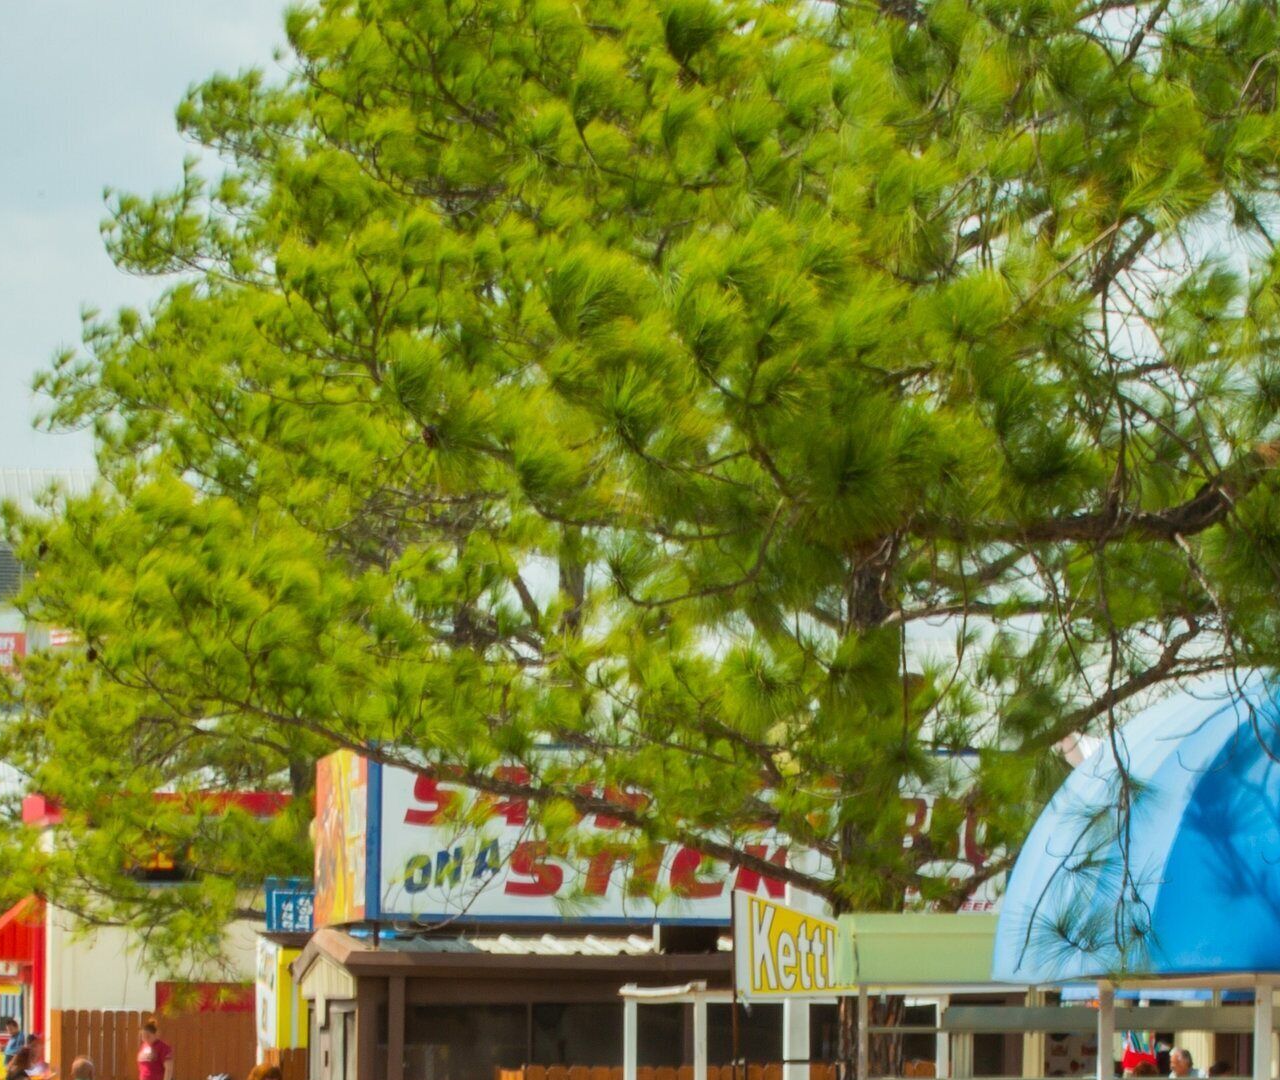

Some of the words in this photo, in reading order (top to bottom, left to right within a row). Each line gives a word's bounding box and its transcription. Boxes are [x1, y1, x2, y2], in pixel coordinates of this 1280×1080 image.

[404, 848, 463, 894] ON
[472, 838, 501, 878] A
[504, 841, 789, 898] STICK
[957, 902, 994, 913] EEF
[750, 899, 835, 991] Kettl
